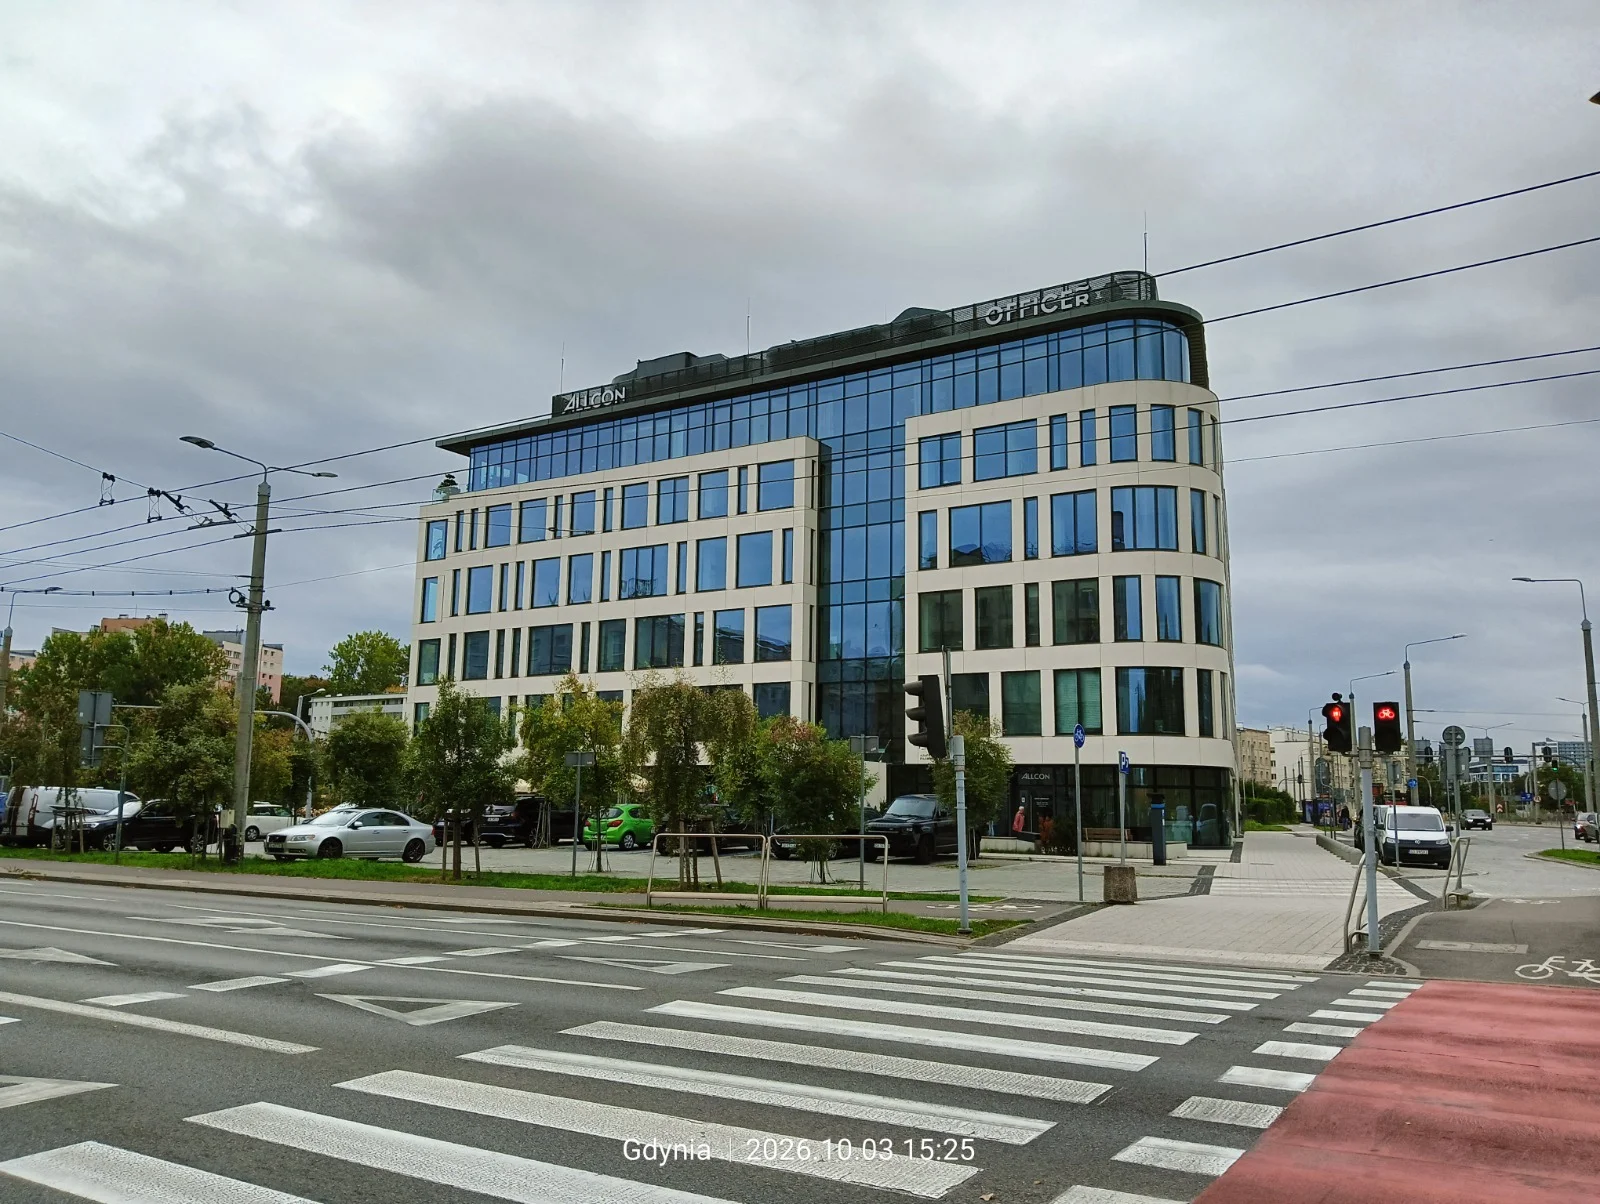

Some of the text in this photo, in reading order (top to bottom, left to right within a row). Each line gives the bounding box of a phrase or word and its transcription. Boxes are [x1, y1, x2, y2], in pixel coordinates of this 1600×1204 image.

[985, 286, 1090, 326] OFFICER
[561, 386, 626, 415] ALLCON
[1021, 772, 1050, 780] ALLCON
